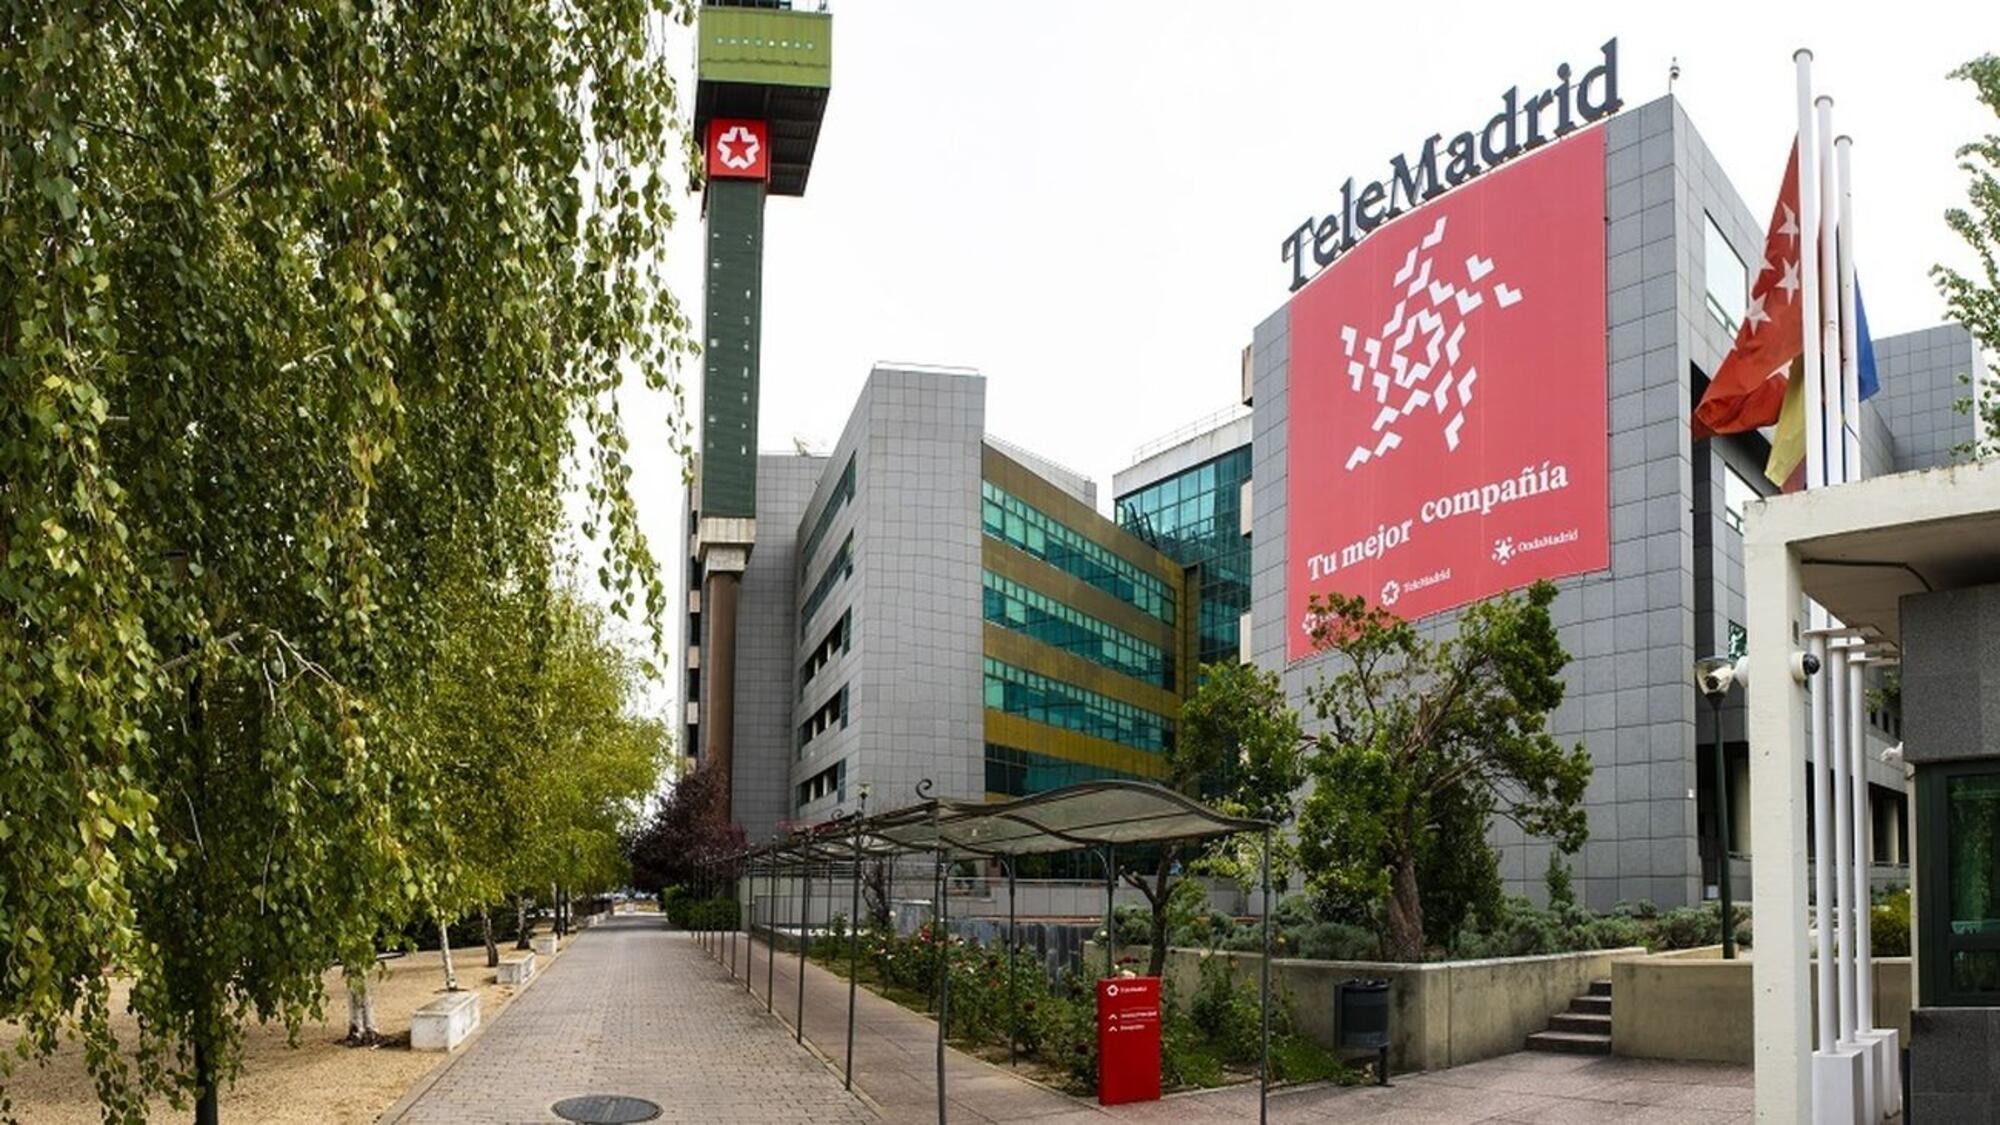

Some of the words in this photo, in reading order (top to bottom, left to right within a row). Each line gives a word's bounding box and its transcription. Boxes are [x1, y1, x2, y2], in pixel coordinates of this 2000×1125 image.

[1281, 36, 1624, 292] TeleMadrid
[1307, 551, 1337, 581] Tu
[1341, 518, 1413, 567] mejor
[1420, 460, 1569, 523] compañía
[1518, 528, 1578, 552] OndaMadrid
